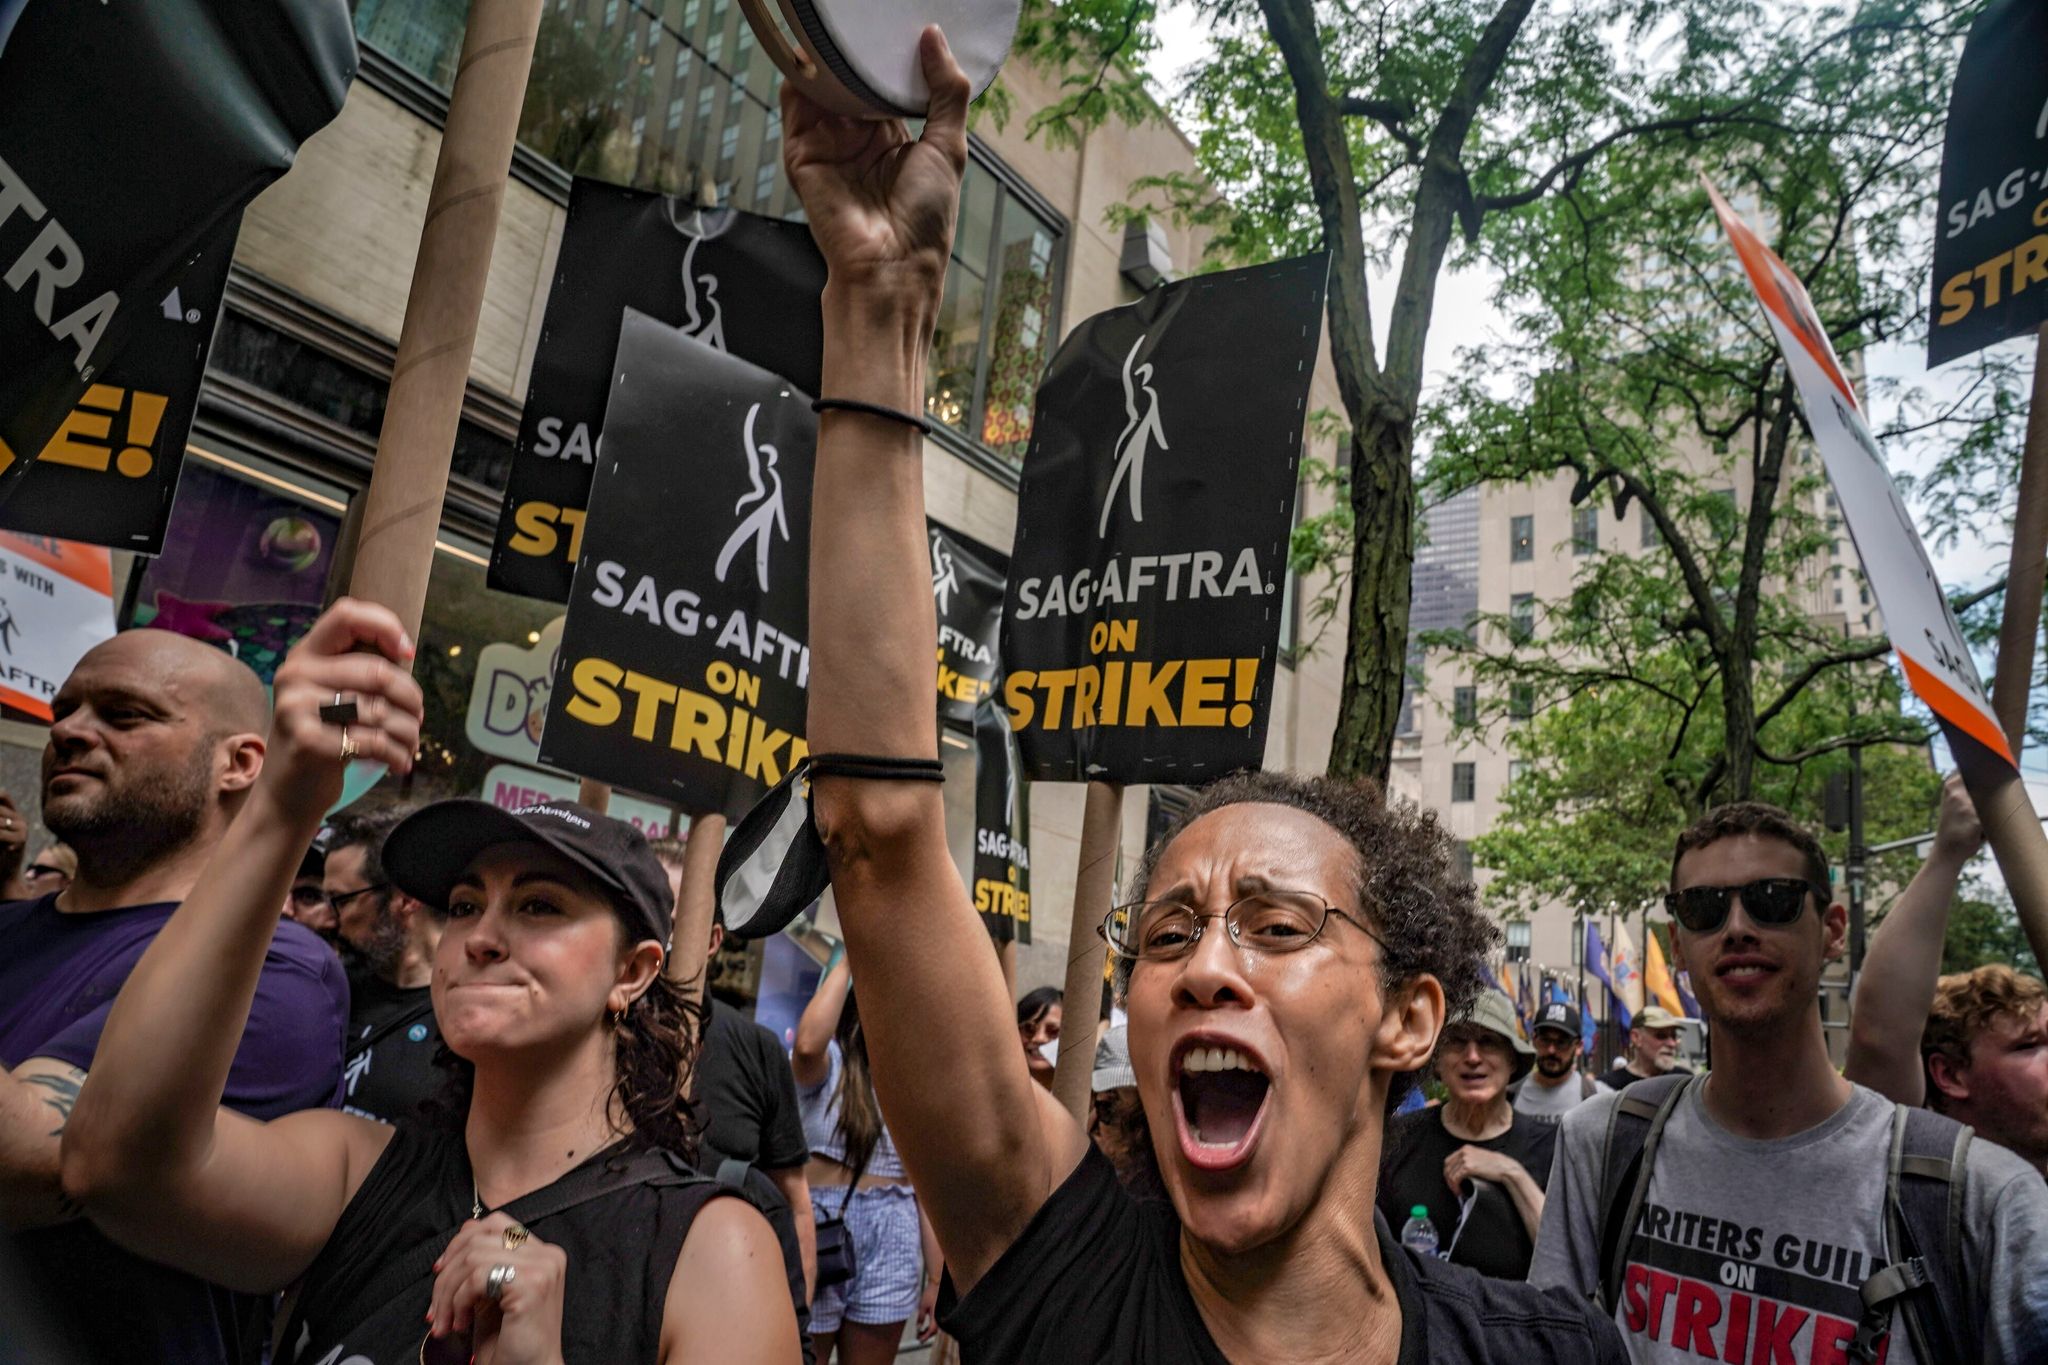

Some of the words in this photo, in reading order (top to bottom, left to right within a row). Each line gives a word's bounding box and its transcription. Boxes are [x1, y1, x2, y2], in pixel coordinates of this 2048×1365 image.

[533, 416, 603, 464] SA
[14, 565, 54, 597] WITH
[1090, 620, 1138, 655] ON
[705, 660, 761, 708] ON
[1004, 658, 1260, 732] STRIKE!
[1719, 1261, 1756, 1291] ON
